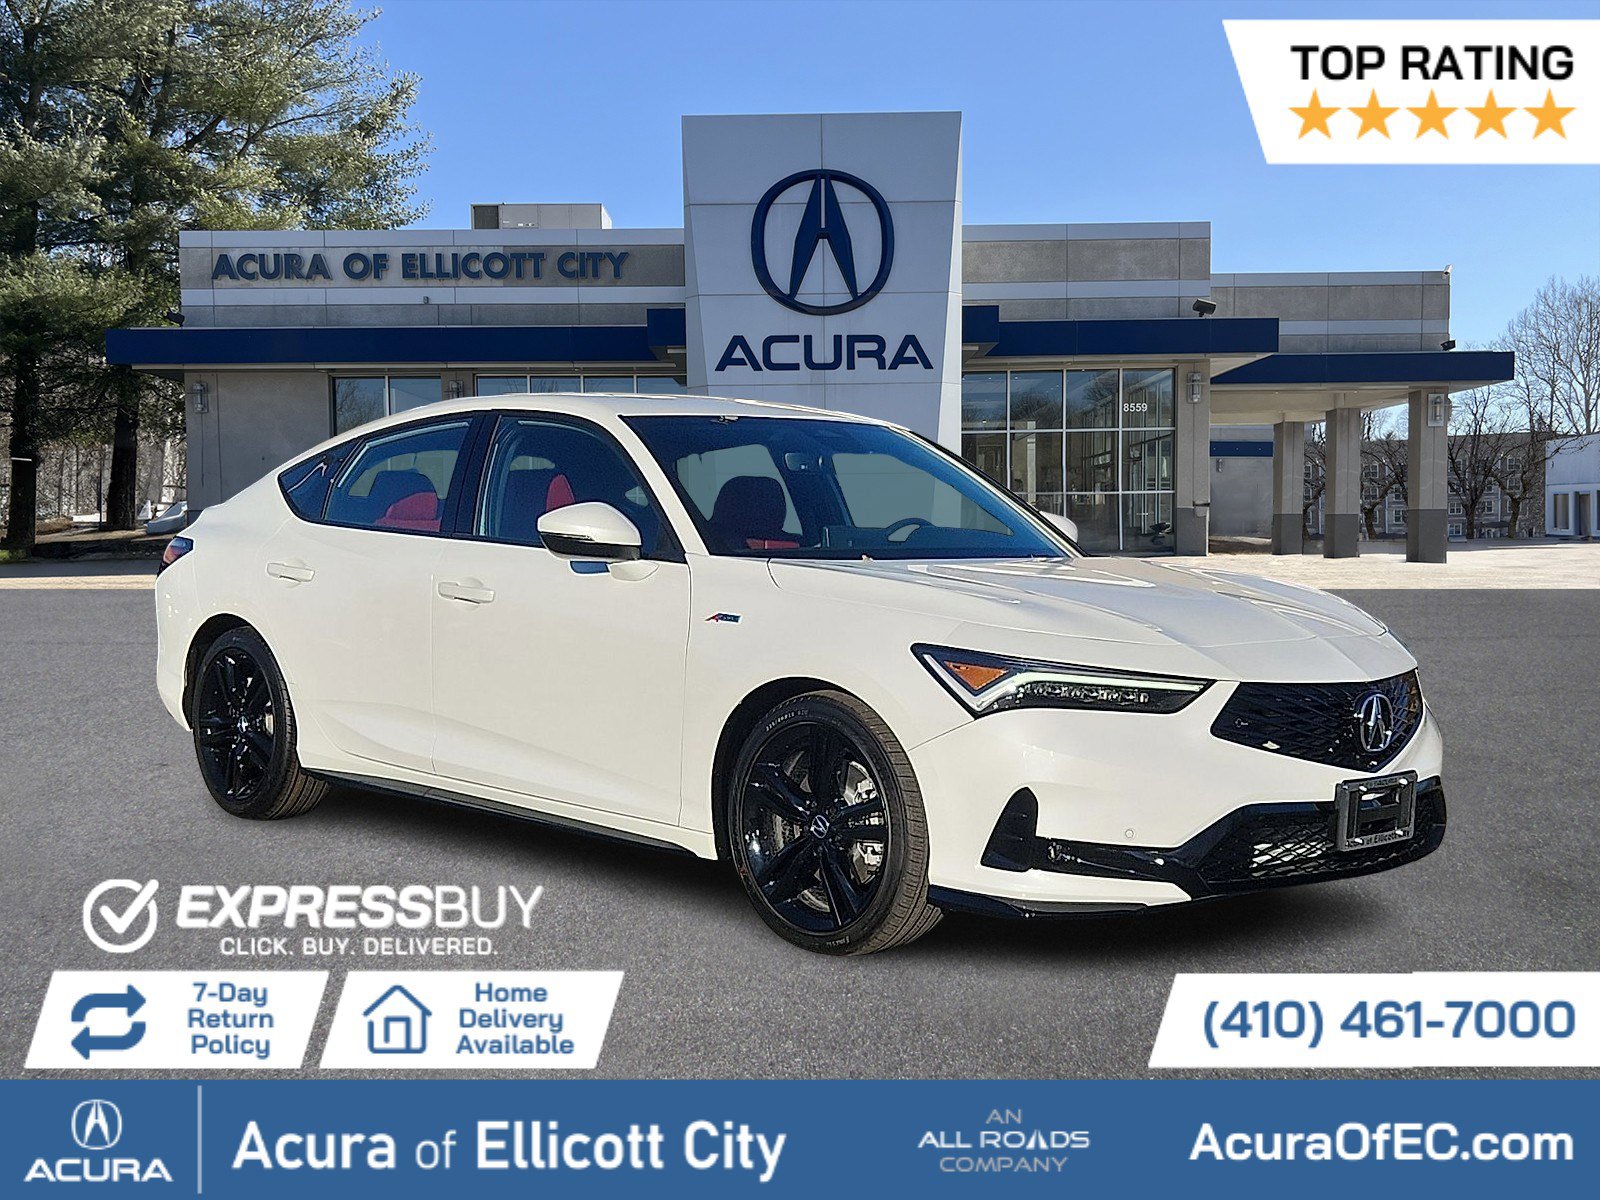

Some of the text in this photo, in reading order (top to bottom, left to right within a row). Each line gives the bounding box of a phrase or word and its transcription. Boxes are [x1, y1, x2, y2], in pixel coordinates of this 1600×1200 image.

[211, 251, 629, 281] ACURA OF ELLICOTT CITY
[714, 334, 934, 371] ACURA
[1123, 402, 1148, 412] 8559
